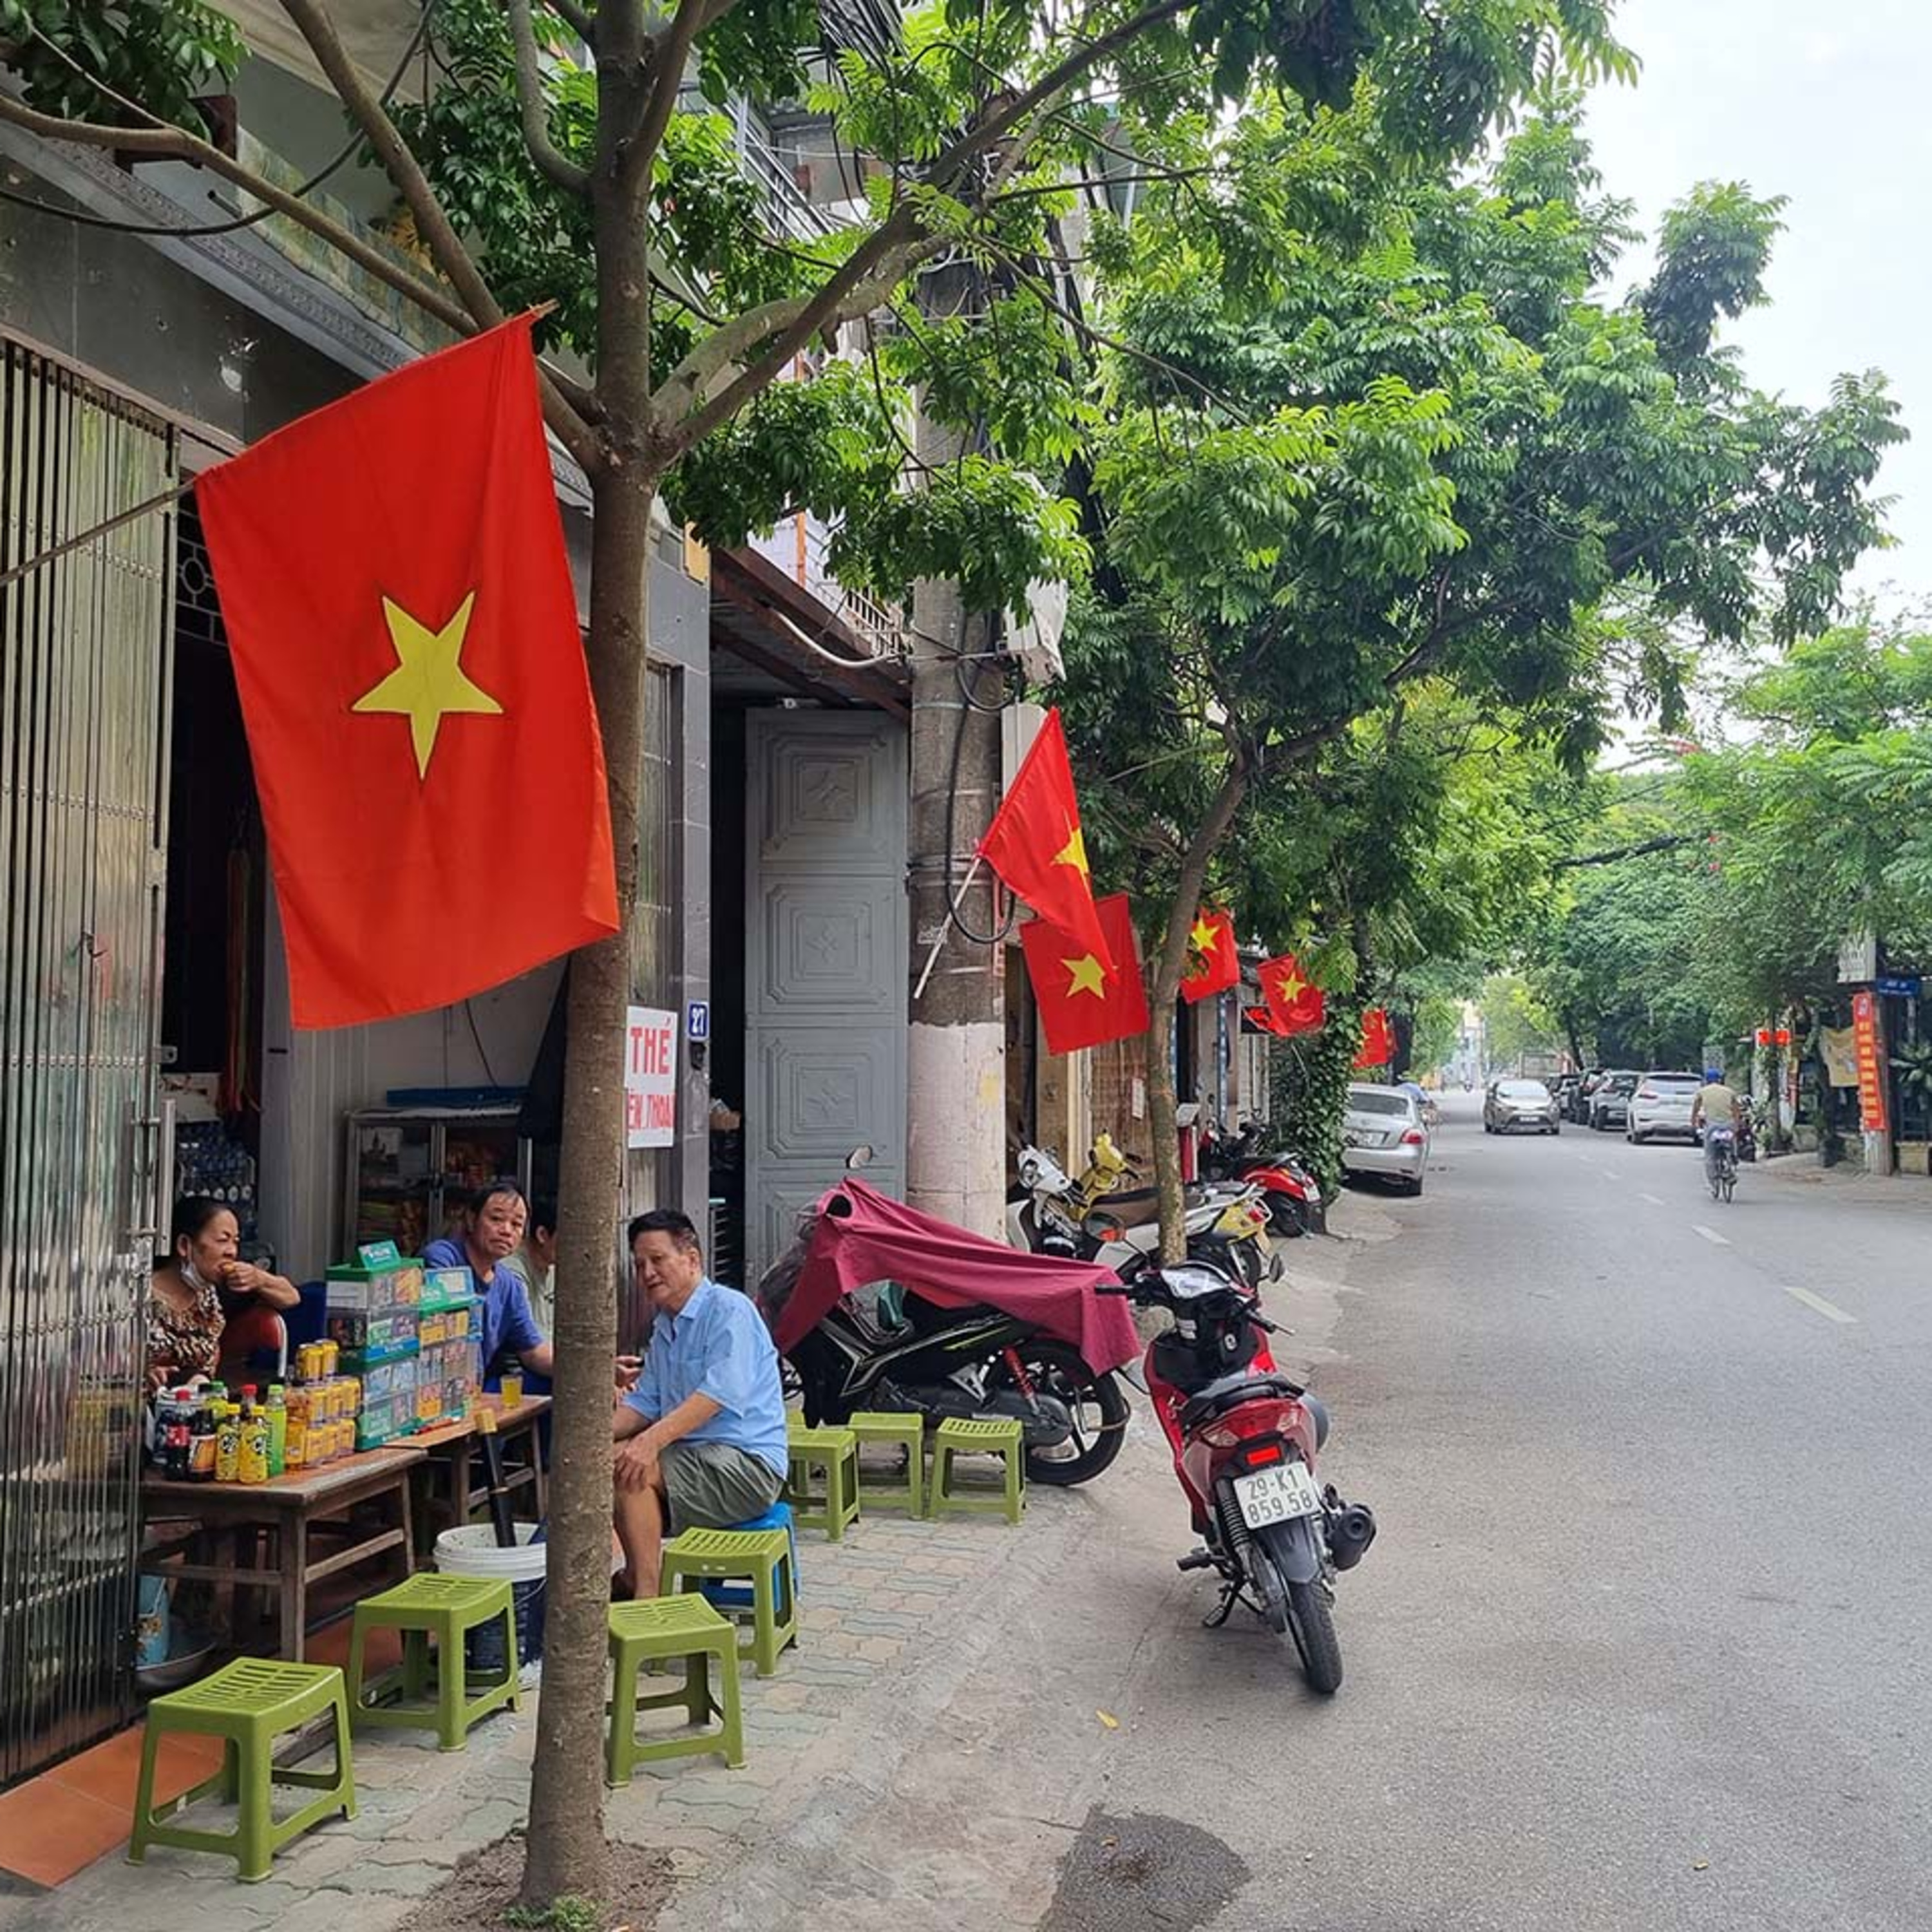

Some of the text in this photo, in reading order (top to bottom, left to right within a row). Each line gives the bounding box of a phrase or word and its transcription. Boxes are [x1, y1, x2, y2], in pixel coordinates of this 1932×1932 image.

[691, 1007, 706, 1035] 27
[1246, 1469, 1299, 1500] 29-K1
[1247, 1490, 1313, 1524] 859.58
